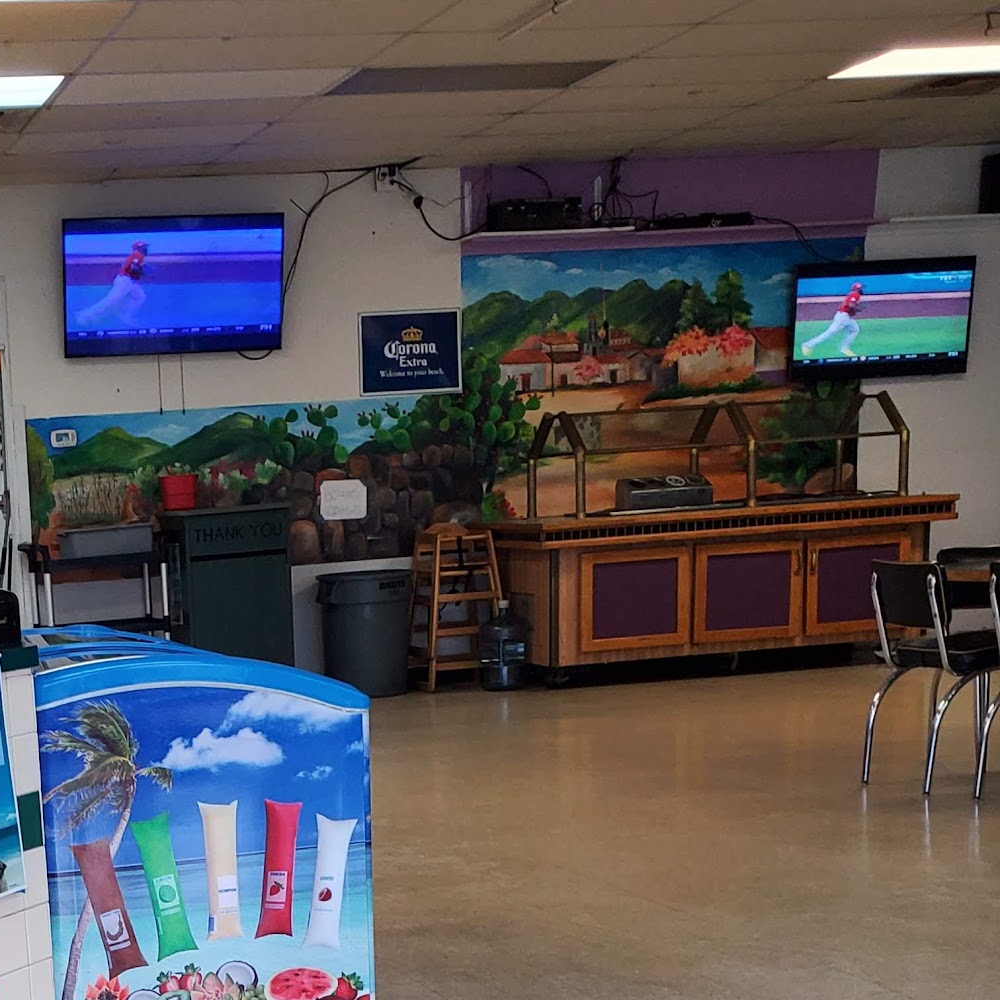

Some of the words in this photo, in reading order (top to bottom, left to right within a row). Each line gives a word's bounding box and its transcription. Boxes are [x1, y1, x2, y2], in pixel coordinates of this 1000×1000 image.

[383, 340, 438, 360] Corona
[399, 356, 428, 367] Extra
[193, 525, 244, 542] THANK
[249, 521, 283, 537] YOU
